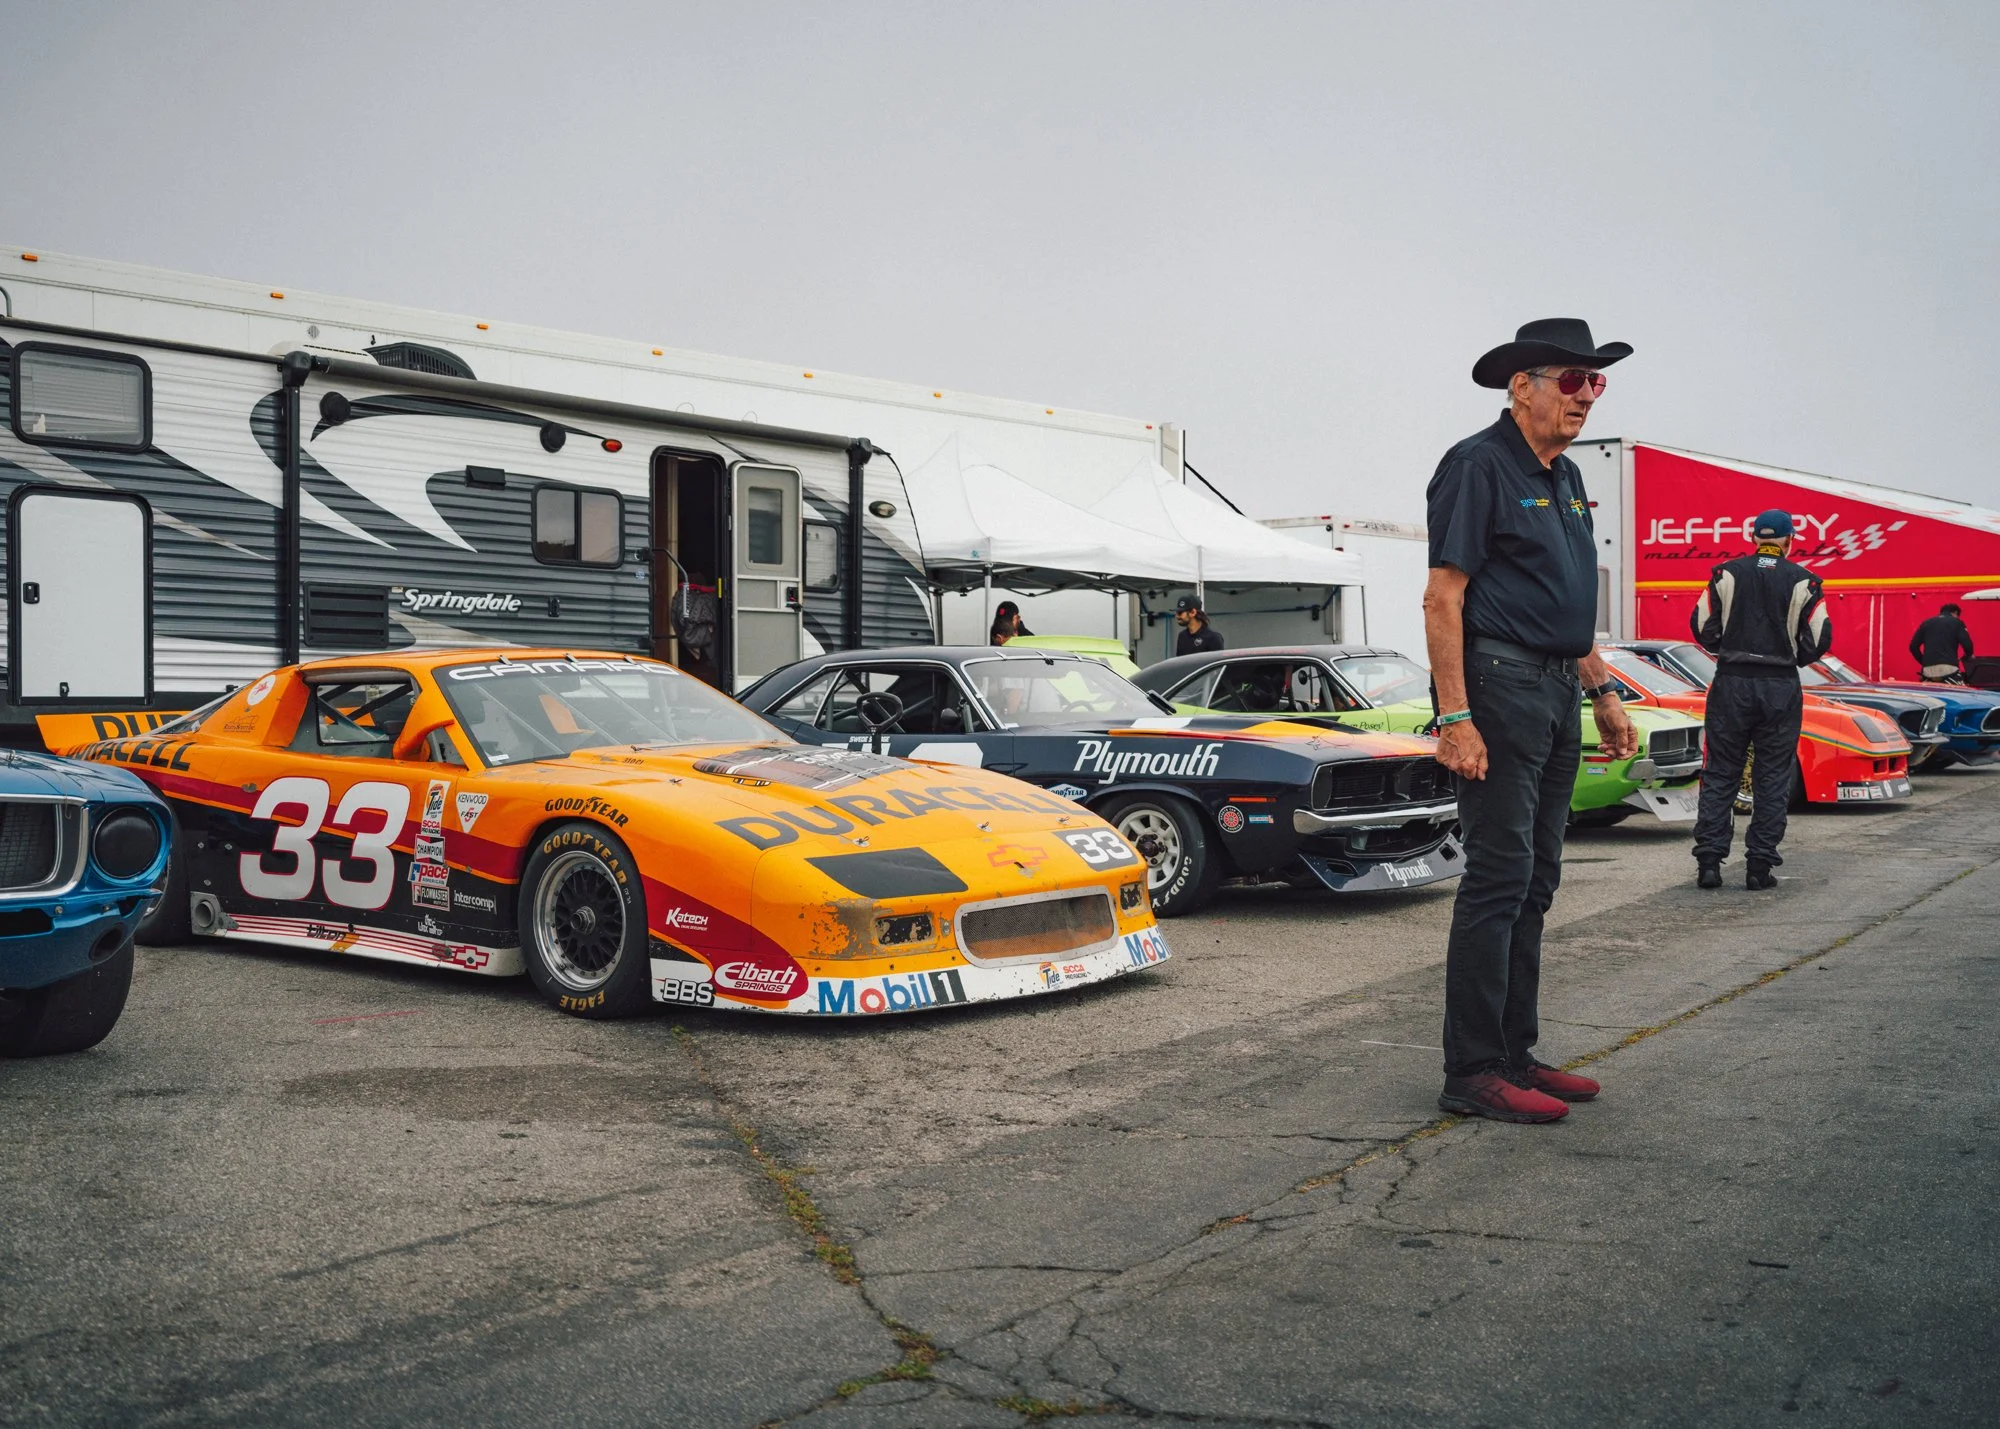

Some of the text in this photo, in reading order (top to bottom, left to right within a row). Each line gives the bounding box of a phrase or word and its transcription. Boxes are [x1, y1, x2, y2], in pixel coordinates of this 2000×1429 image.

[402, 588, 521, 613] Springdale
[448, 661, 681, 681] CAMARO
[91, 713, 183, 742] DU
[1073, 739, 1224, 785] Plymouth
[426, 791, 443, 816] Tide
[458, 794, 487, 805] KENWOOD
[422, 819, 441, 829] SCCA
[714, 785, 1096, 852] DURACELL
[239, 775, 411, 912] 33
[417, 844, 443, 857] CHAMPION
[1065, 829, 1134, 864] 33
[418, 864, 449, 883] pace
[1379, 857, 1434, 888] Plymouth
[714, 961, 798, 988] Eibach
[1042, 967, 1061, 989] Tide
[1062, 963, 1085, 974] SCCA
[661, 978, 715, 1005] BBS
[734, 980, 785, 993] SPRINGS
[817, 973, 933, 1015] Mobil
[559, 989, 606, 1012] EAGLE
